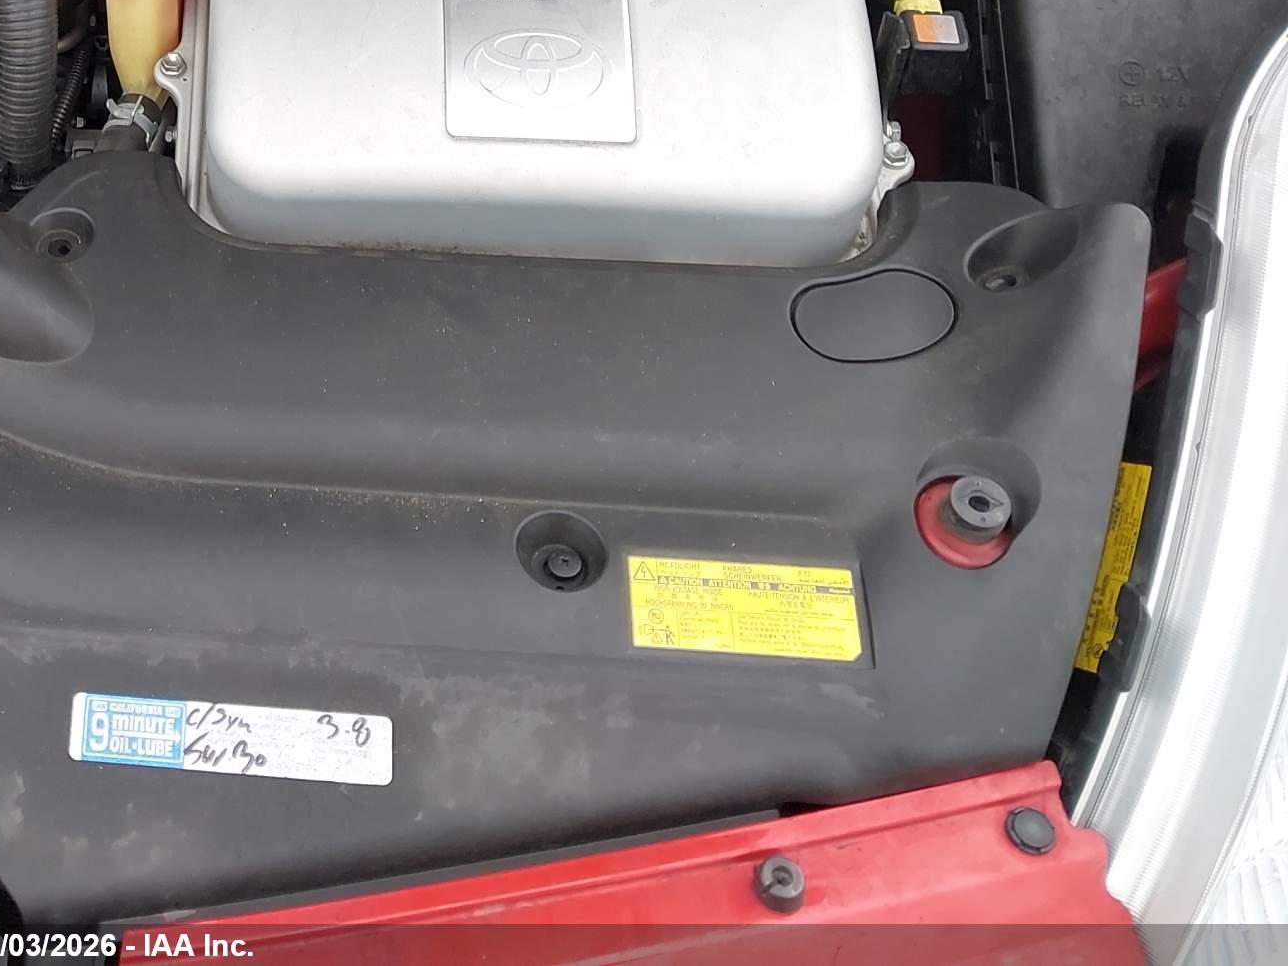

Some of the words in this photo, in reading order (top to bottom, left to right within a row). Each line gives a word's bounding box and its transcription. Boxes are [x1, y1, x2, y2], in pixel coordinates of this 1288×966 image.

[670, 577, 702, 585] CAUTION
[709, 579, 751, 589] ATTENTION
[89, 713, 109, 752] 9
